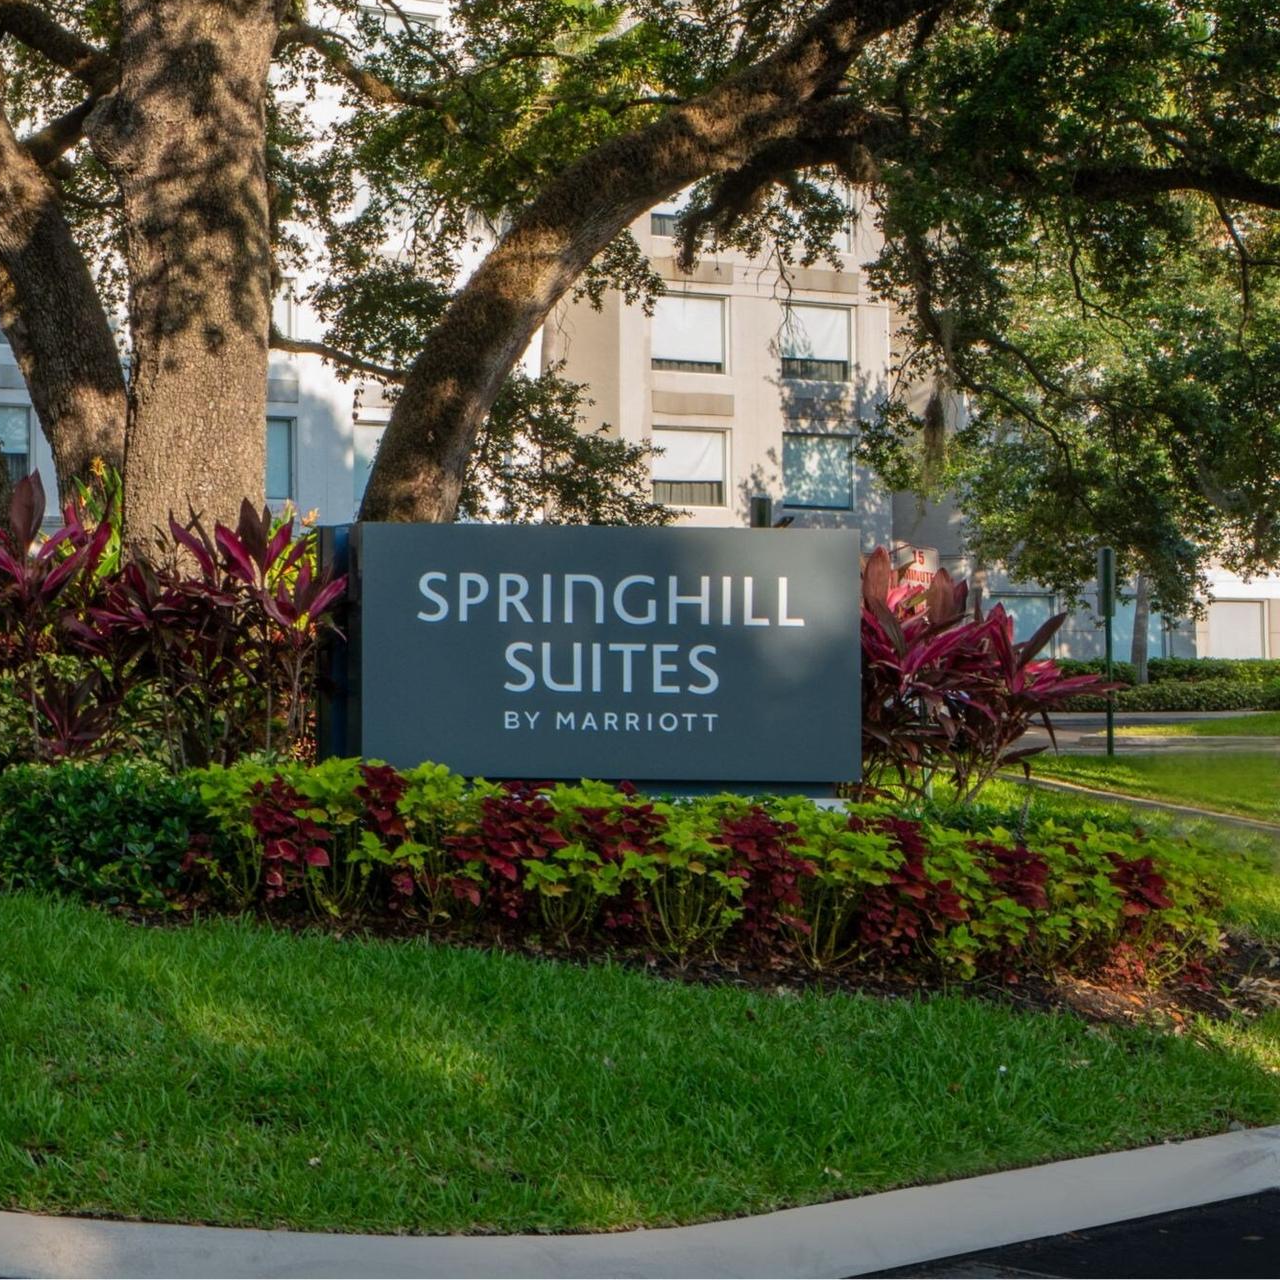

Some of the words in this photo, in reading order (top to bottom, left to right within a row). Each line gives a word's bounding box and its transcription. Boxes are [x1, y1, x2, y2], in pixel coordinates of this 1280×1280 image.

[912, 549, 925, 565] 15
[417, 571, 805, 627] SPRINGHILL
[503, 641, 720, 694] SUITES
[504, 711, 541, 729] BY
[556, 712, 719, 733] MARRIOTT
